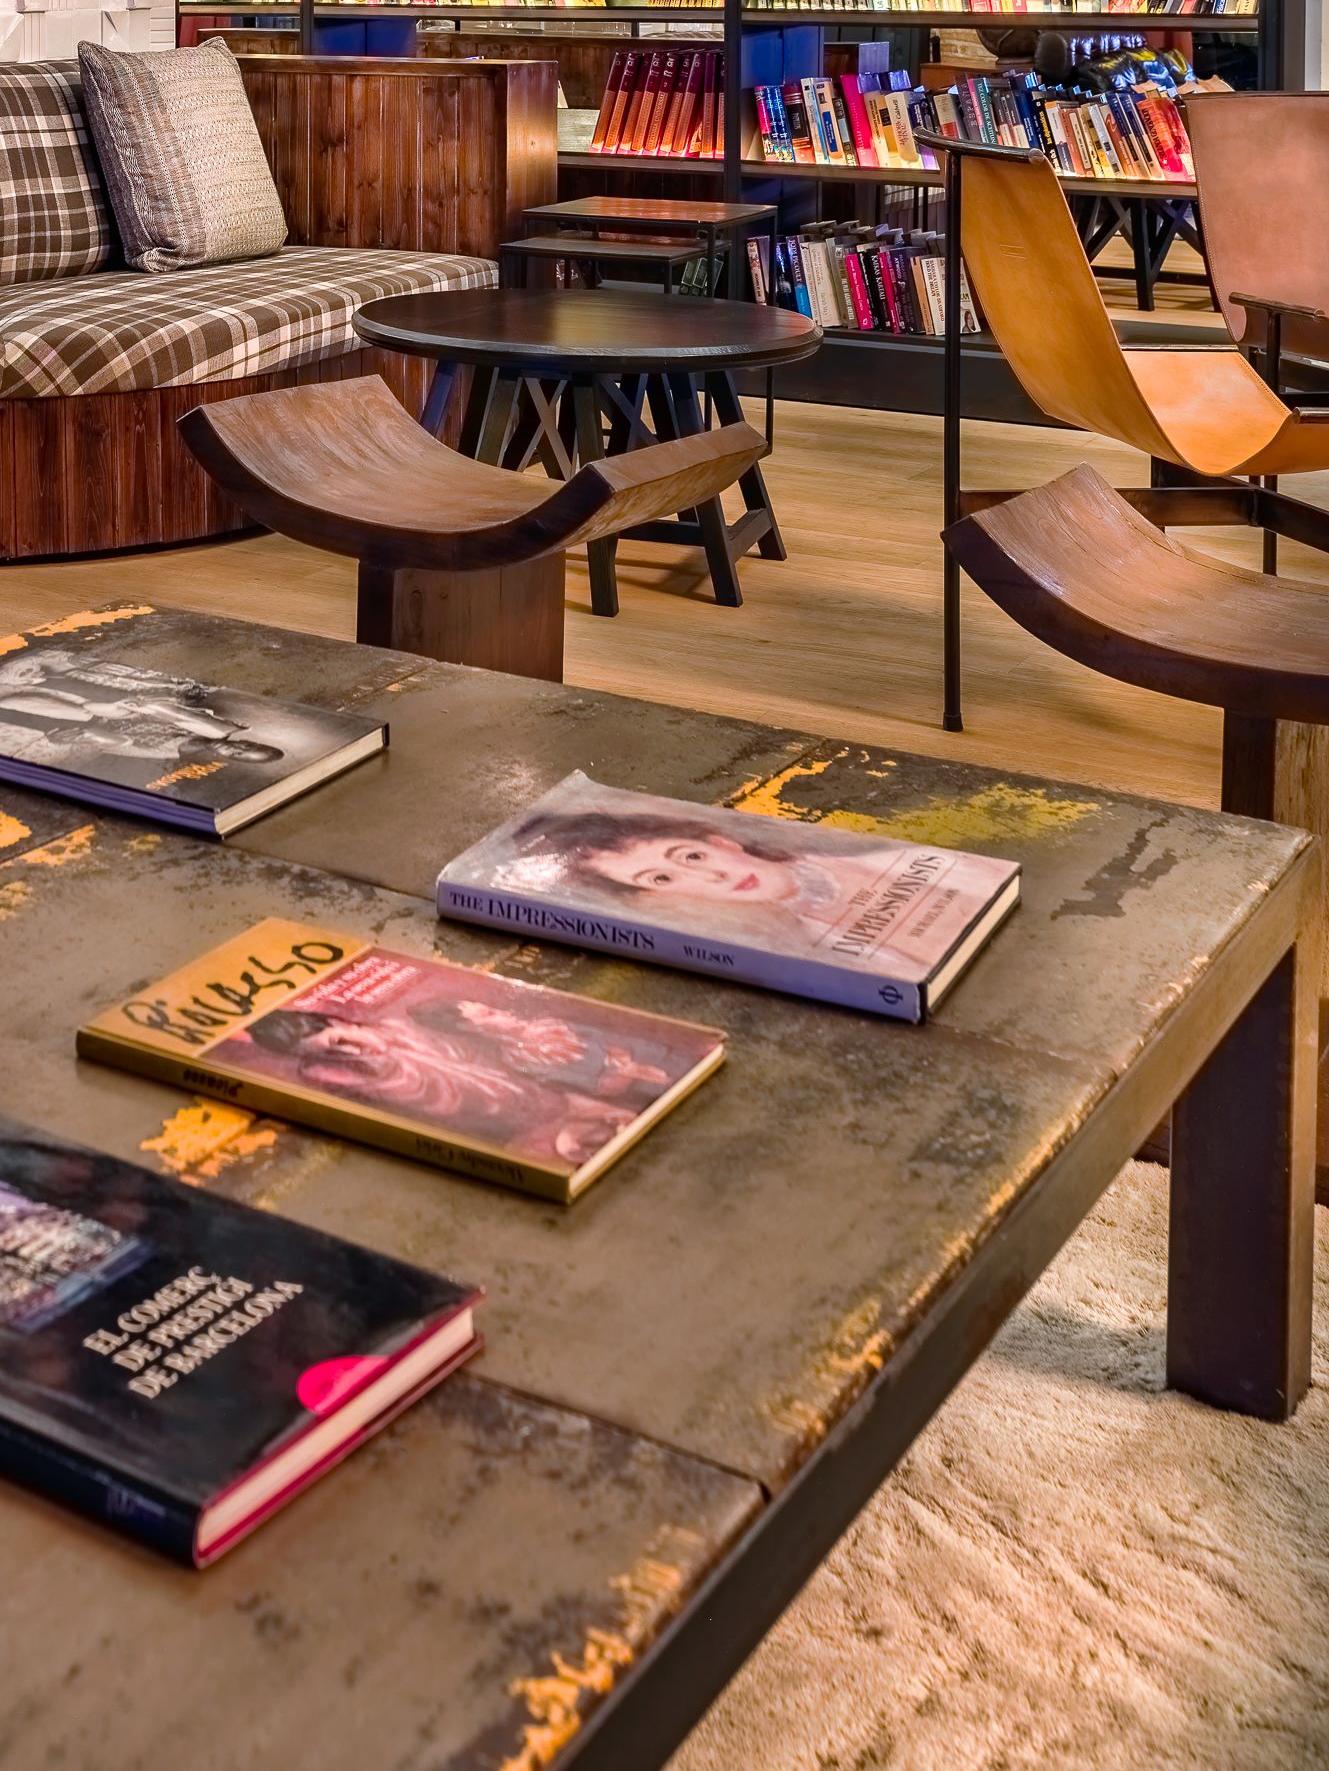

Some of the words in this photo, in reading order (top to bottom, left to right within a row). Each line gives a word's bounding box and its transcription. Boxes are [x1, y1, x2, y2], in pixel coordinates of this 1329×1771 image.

[448, 890, 486, 917] THE
[485, 891, 656, 952] IMPRESSIONISTS
[681, 944, 736, 968] WILSON
[831, 852, 947, 957] IMPRESSIONISTS
[82, 1326, 129, 1357] EL
[117, 1264, 223, 1334] COMERÇ
[112, 1340, 164, 1373] DE
[147, 1276, 255, 1348] PRESTIGI
[127, 1363, 178, 1400] DE
[163, 1279, 306, 1376] BARCELONA
